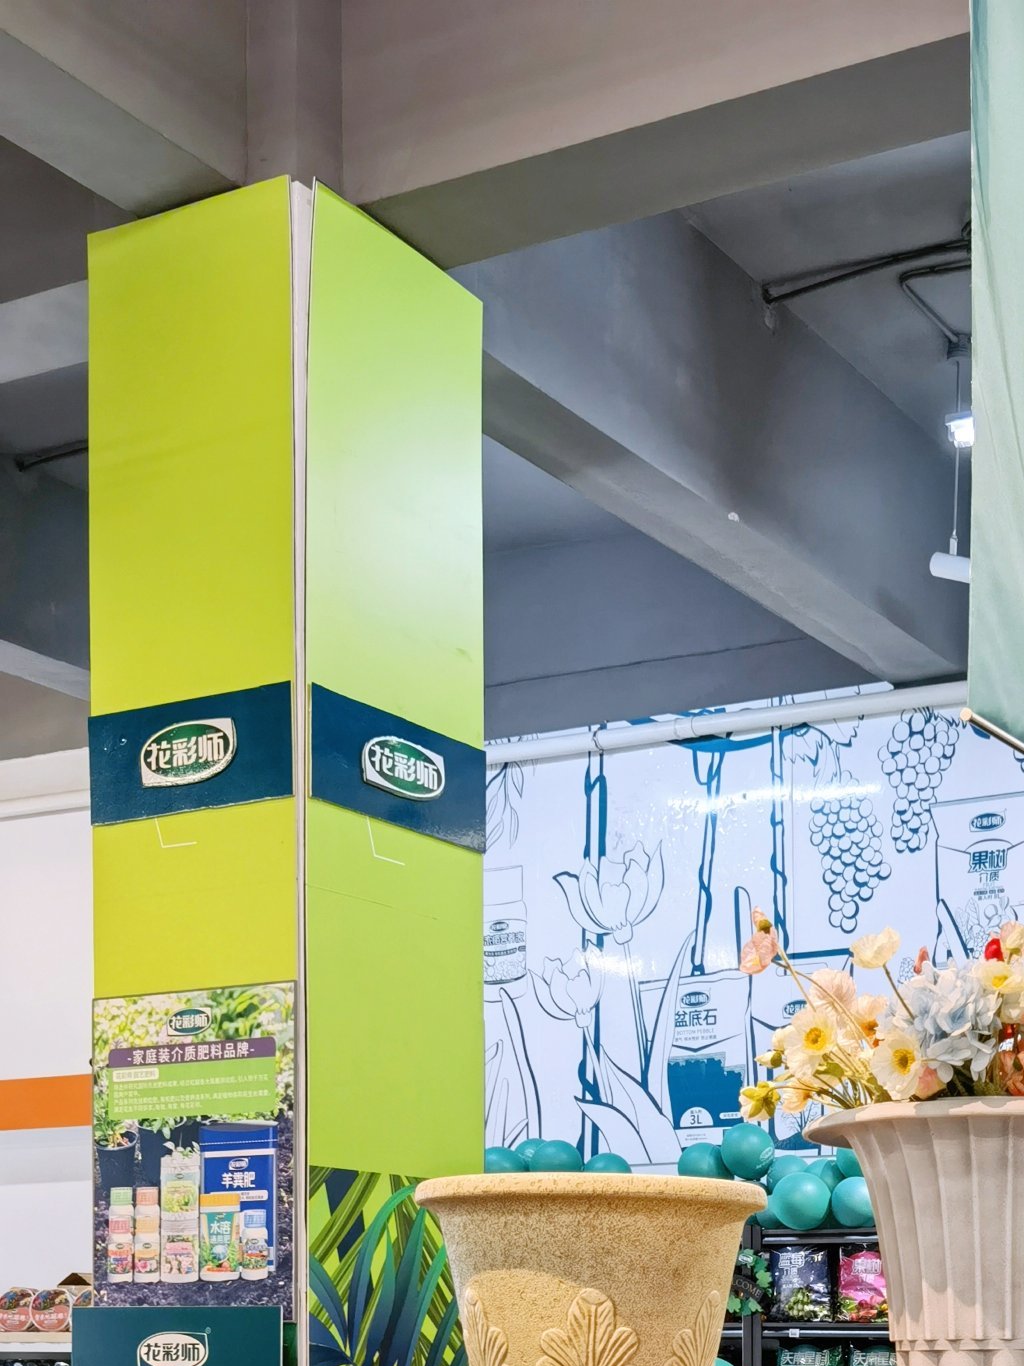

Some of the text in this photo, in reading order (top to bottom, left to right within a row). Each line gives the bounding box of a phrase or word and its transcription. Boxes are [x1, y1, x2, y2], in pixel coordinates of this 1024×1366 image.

[147, 734, 225, 770] 花彩师
[371, 746, 439, 790] 花彩师
[972, 849, 1006, 870] 果树
[170, 1013, 209, 1030] 花彩师
[675, 1008, 718, 1027] 盆底石
[690, 1114, 702, 1125] 3L
[144, 1342, 201, 1362] 花彩师
